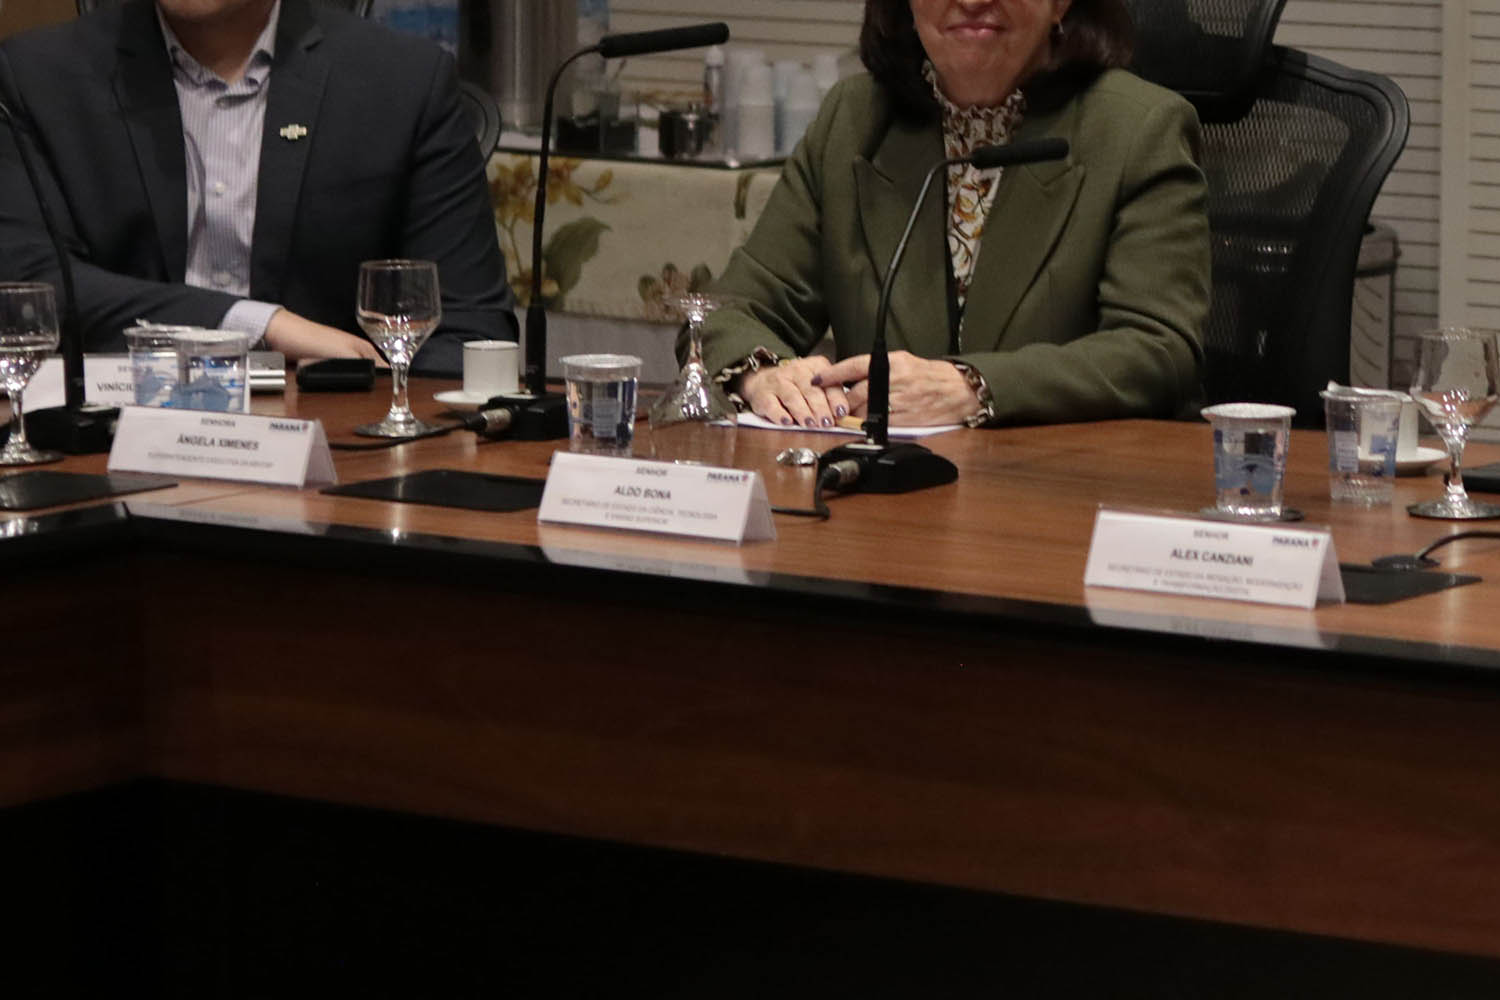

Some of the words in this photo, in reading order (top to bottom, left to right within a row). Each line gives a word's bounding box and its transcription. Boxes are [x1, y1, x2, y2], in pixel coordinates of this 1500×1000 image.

[218, 438, 259, 450] XIMENES
[614, 485, 641, 498] ALDO
[643, 488, 672, 500] BONA
[1170, 548, 1199, 562] ALEX
[1201, 550, 1254, 567] CANZIANI
